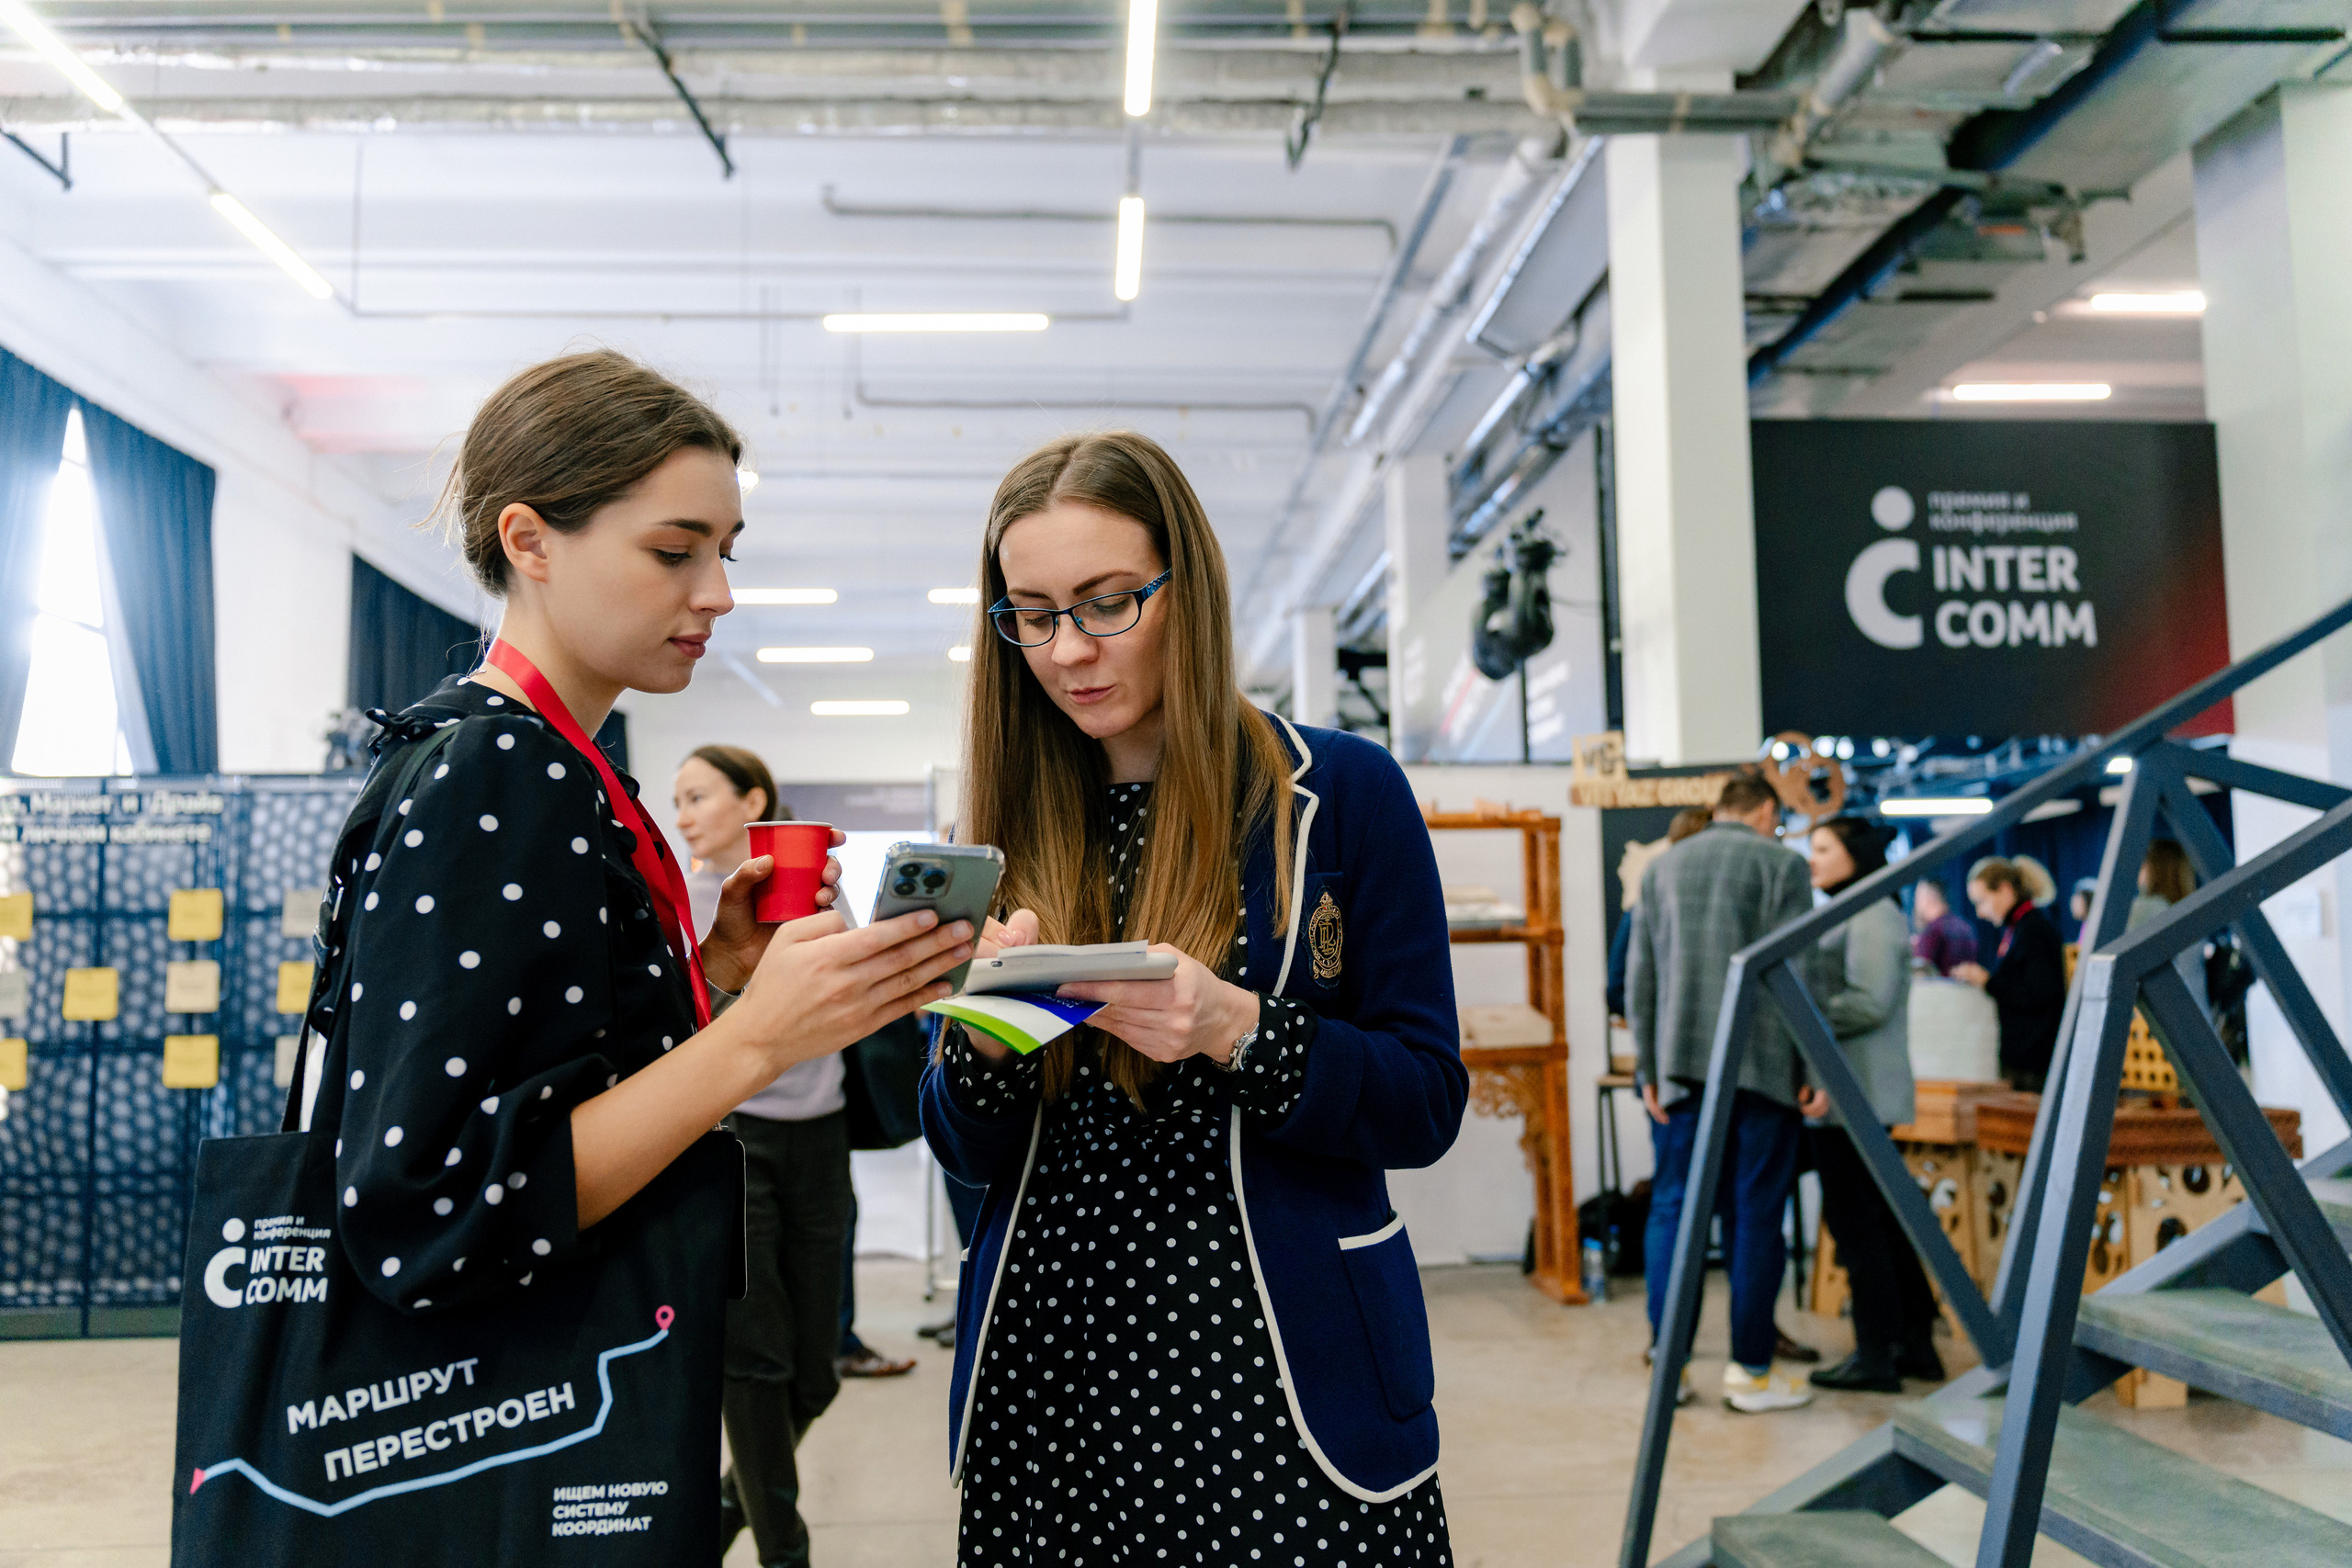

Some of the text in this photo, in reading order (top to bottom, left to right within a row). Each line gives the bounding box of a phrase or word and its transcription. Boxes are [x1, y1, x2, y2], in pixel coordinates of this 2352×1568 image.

[1929, 512, 2078, 536] конференция
[1933, 545, 2079, 592] INTER
[1935, 600, 2098, 649] COMM
[1657, 776, 1725, 807] GROU
[249, 1245, 327, 1275] INTER
[244, 1276, 329, 1305] COMM
[287, 1358, 479, 1435] МАРШРУТ
[324, 1382, 576, 1483] ПЕРЕСТРОЕН
[553, 1481, 669, 1503] ИЩЕМ НОВУЮ
[552, 1500, 630, 1520] СИСТЕМУ
[551, 1516, 652, 1537] КООРДИНАТ
